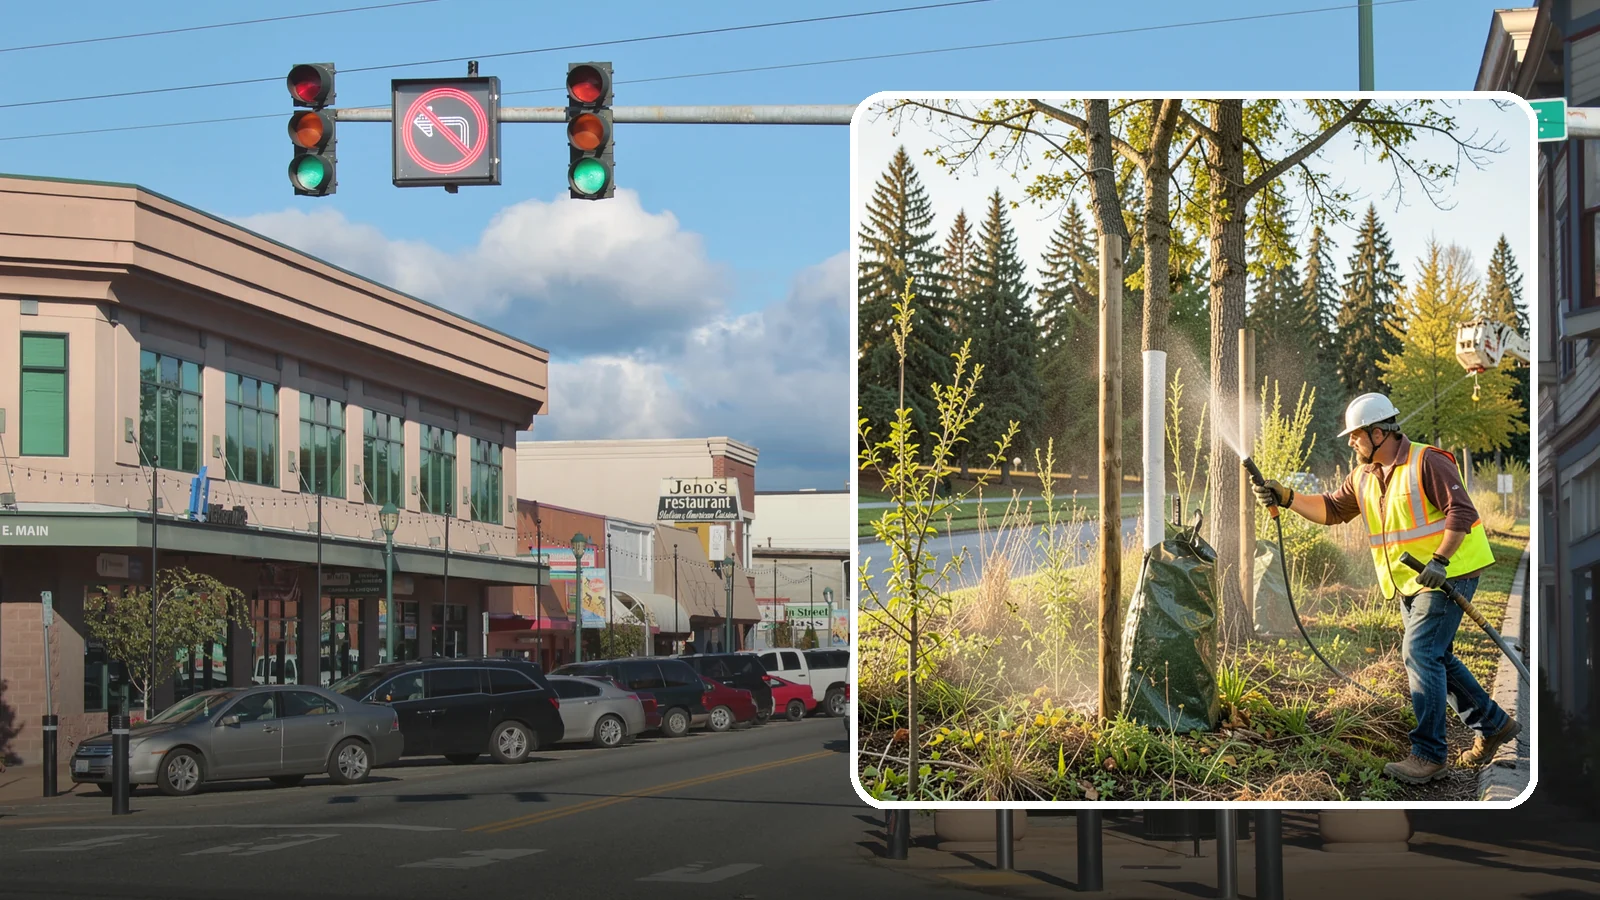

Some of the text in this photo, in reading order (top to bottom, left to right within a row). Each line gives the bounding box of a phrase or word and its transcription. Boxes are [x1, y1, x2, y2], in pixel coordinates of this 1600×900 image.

[670, 480, 727, 494] Jeno's
[665, 496, 730, 508] restaurant
[658, 510, 681, 519] Italian
[686, 509, 714, 519] American
[715, 509, 738, 519] Cuisine
[2, 525, 49, 536] E. MAIN
[797, 608, 828, 616] Street
[791, 619, 823, 627] lass
